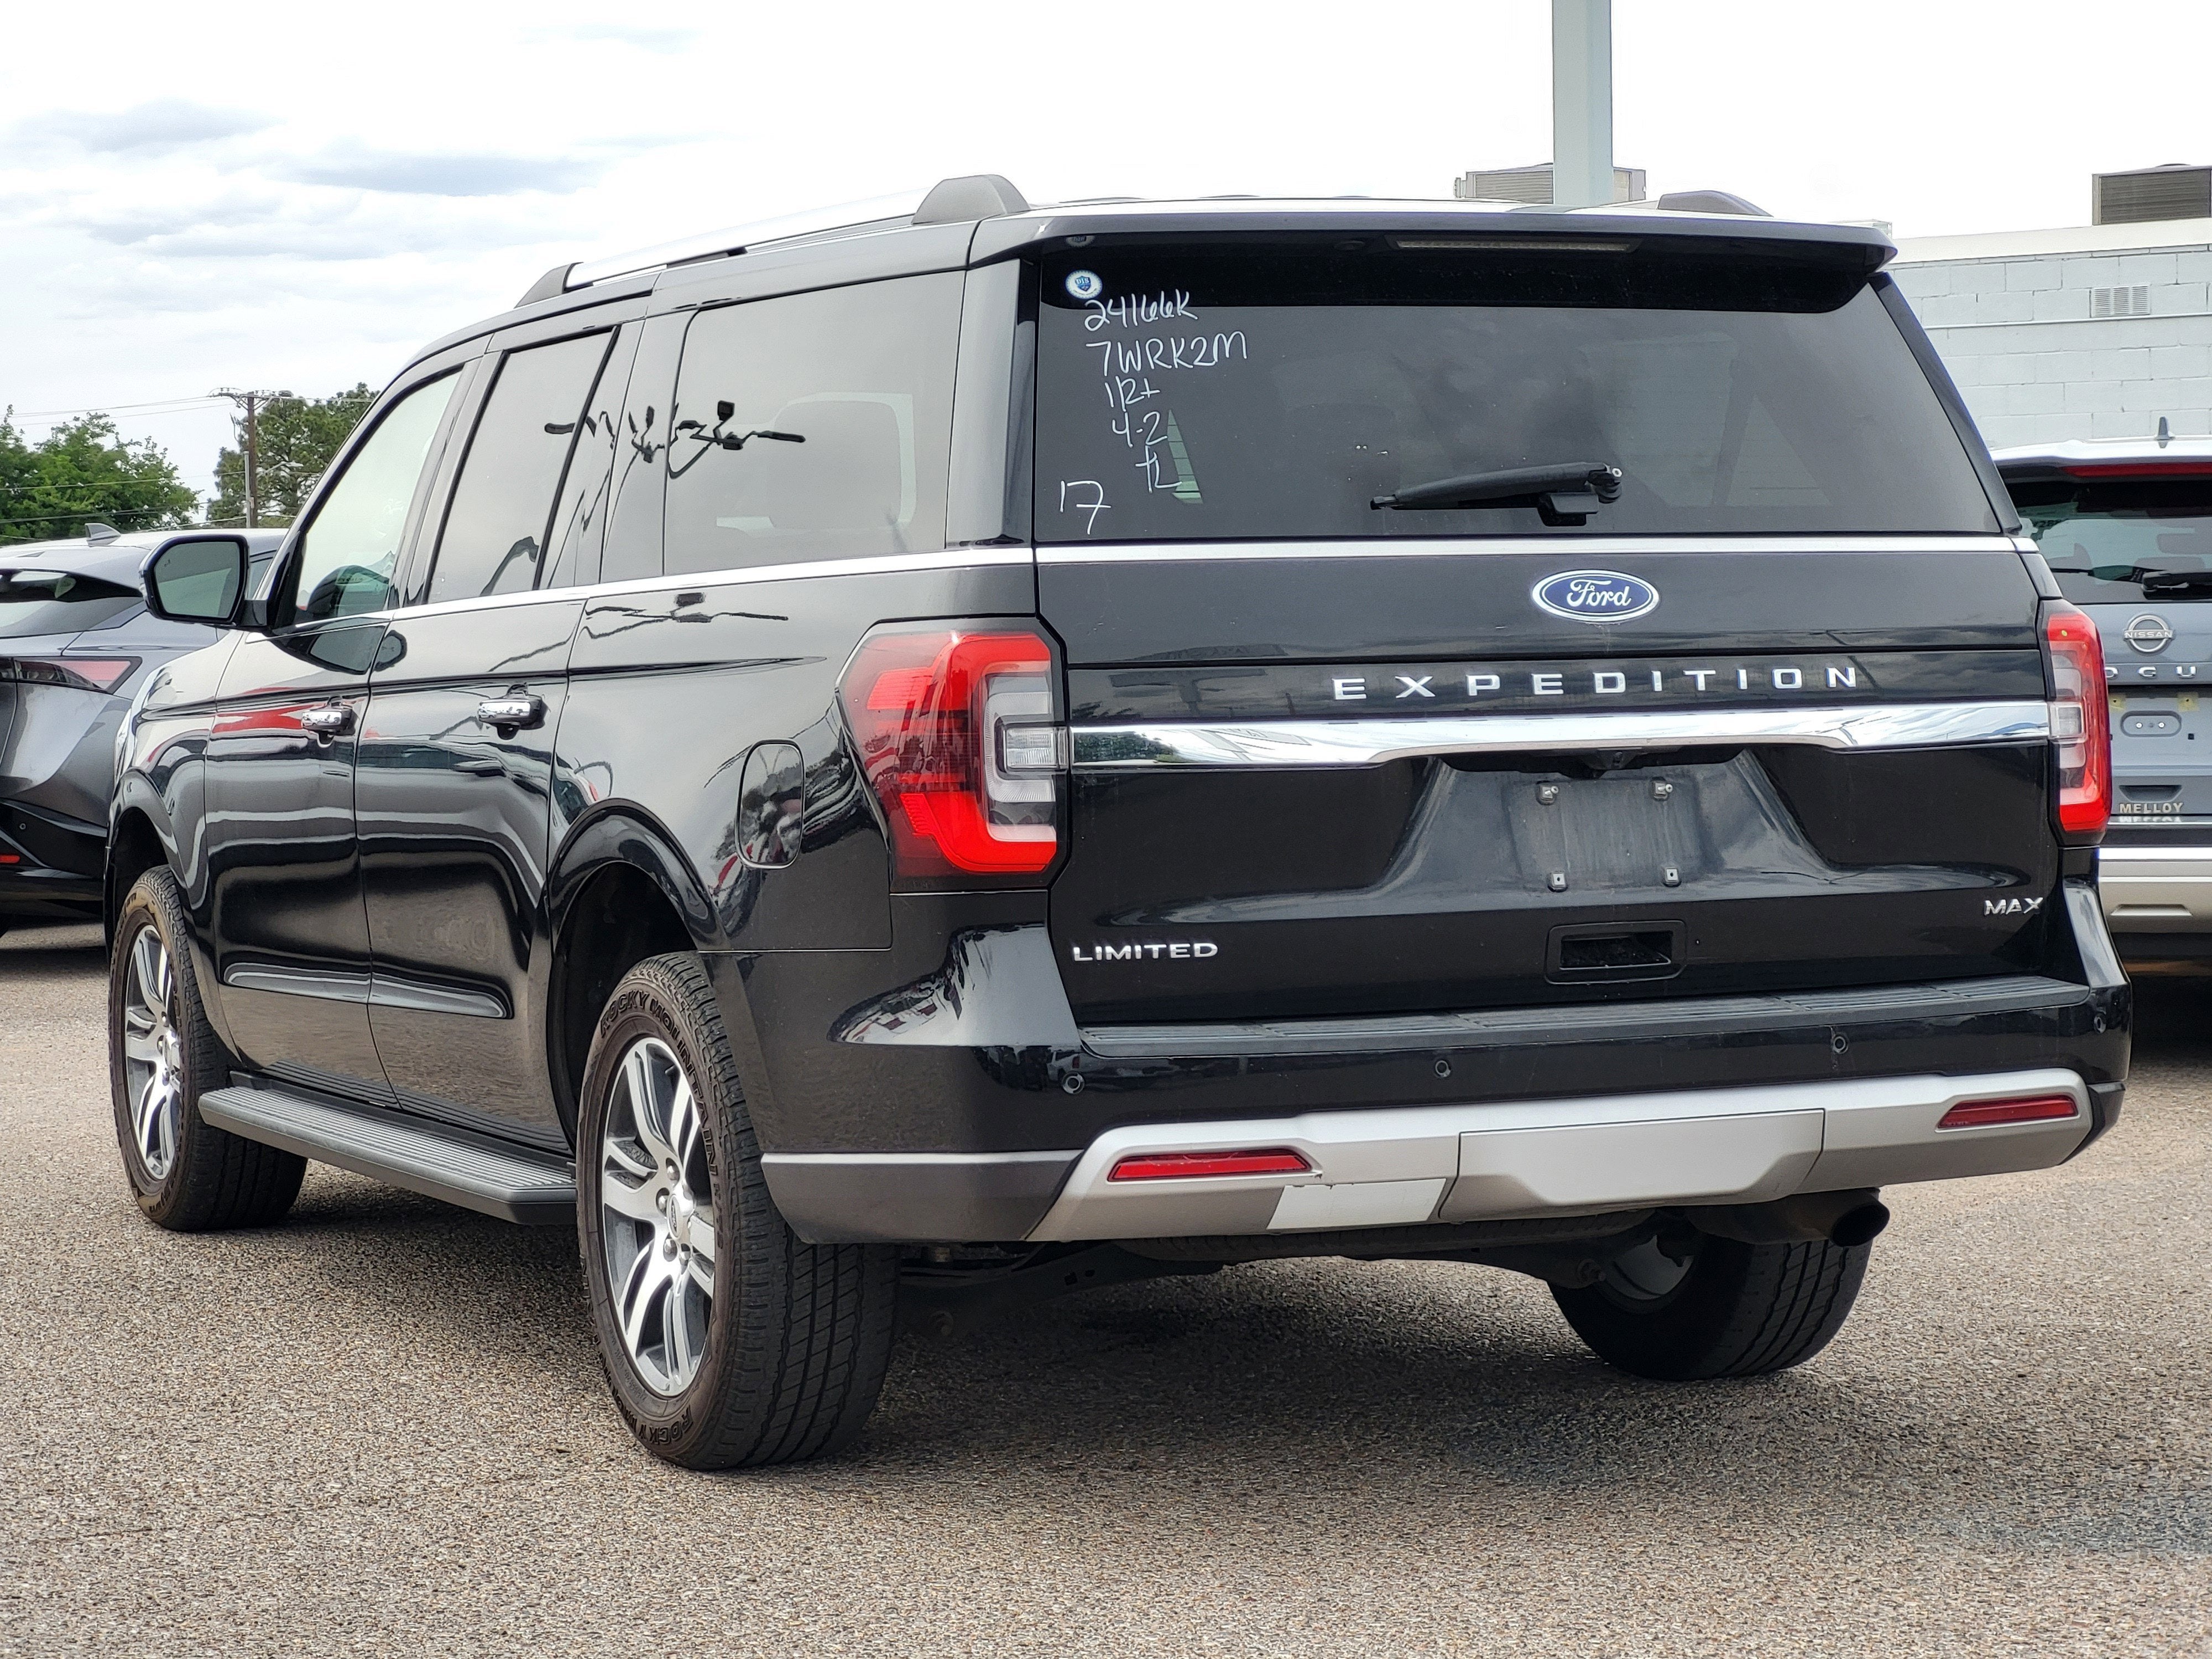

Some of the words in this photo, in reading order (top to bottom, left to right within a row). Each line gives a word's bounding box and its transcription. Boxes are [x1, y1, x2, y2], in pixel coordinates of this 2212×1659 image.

[1566, 578, 1632, 607] Ford
[1332, 666, 1857, 700] EXPEDITION
[2119, 802, 2184, 814] MELLOY
[1983, 896, 2043, 916] MAX
[1073, 942, 1218, 962] LIMITED
